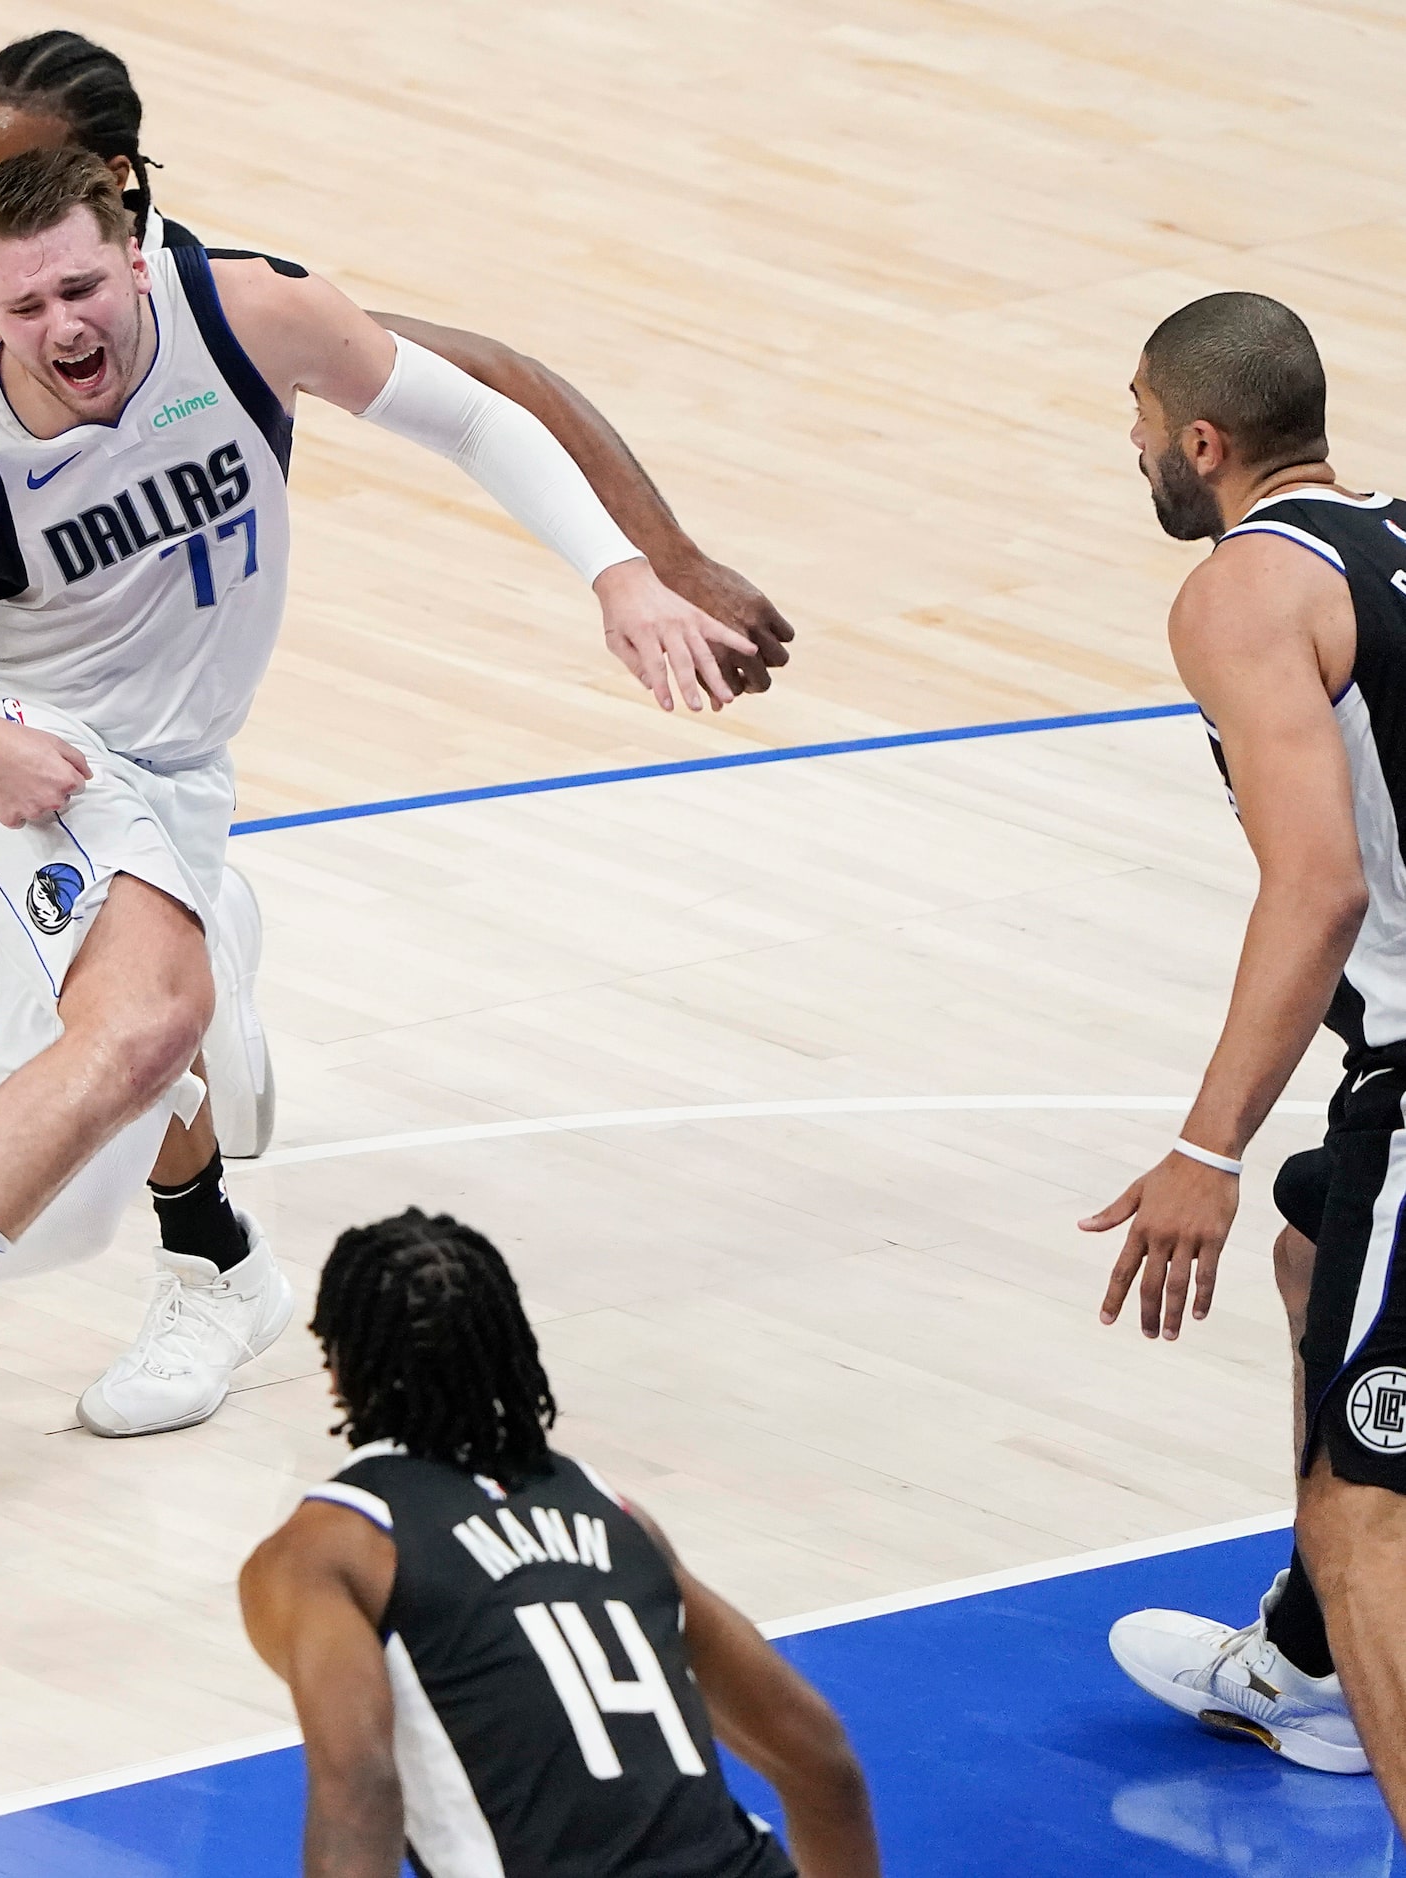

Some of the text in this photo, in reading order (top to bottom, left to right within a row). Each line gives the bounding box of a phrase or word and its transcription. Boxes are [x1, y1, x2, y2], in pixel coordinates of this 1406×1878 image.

[153, 390, 219, 428] chime
[41, 439, 252, 586] DALLAS
[159, 506, 259, 610] 77
[452, 1506, 613, 1581] MANN
[513, 1600, 707, 1780] 14
